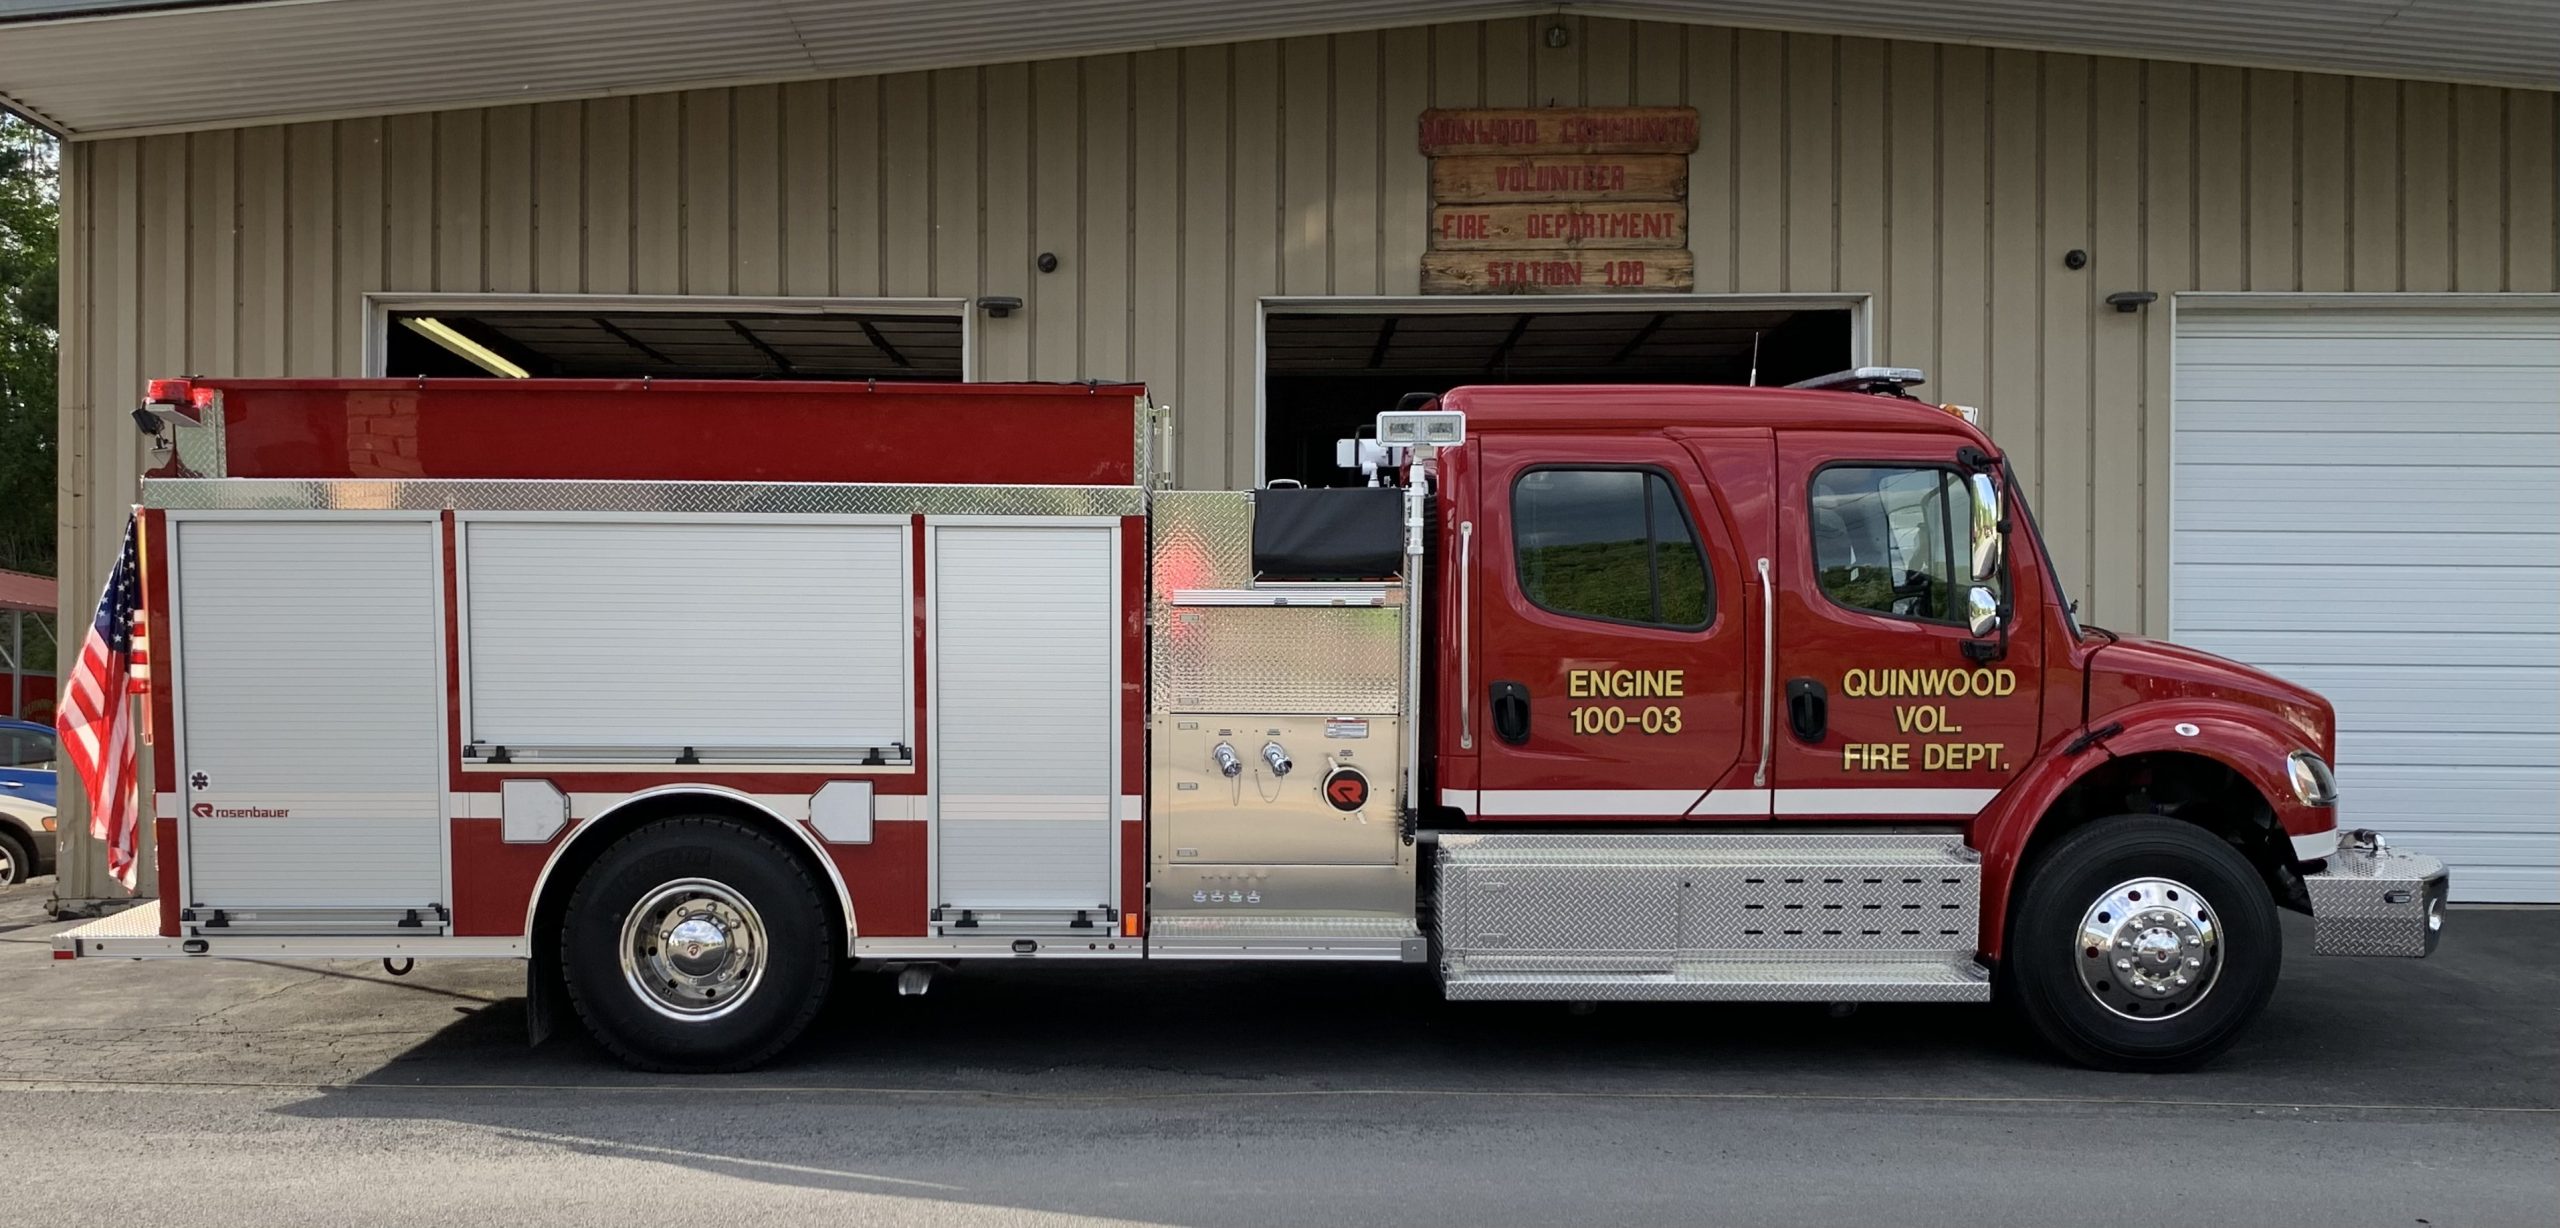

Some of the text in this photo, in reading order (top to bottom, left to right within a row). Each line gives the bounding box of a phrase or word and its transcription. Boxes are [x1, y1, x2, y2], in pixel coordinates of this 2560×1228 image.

[1561, 116, 1697, 145] COMMUNITY
[1496, 165, 1624, 191] VOLUNTEER
[1442, 213, 1675, 239] FIRE DEPARTMENT
[1487, 261, 1644, 286] STATION 100
[1569, 669, 1684, 698] ENGINE
[1843, 668, 2016, 697] QUINWOOD
[1570, 706, 1682, 735] 100-03
[1896, 706, 1962, 733] VOL.
[1844, 743, 2010, 771] FIRE DEPT.
[215, 806, 290, 818] rosenbauer
